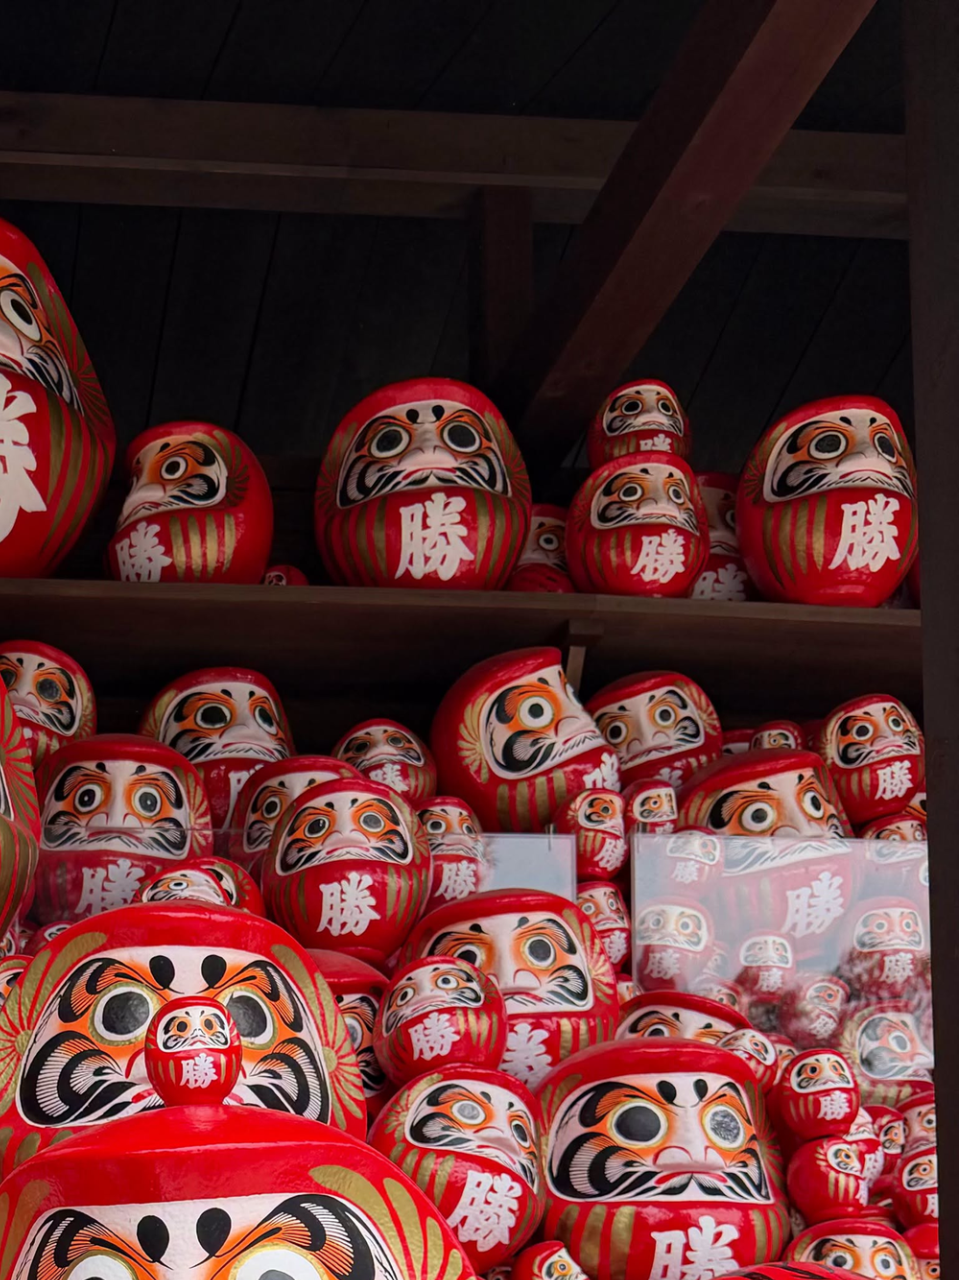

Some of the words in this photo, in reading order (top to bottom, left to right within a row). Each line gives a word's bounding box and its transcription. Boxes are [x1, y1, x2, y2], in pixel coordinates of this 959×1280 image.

[115, 521, 172, 582] 勝
[395, 492, 474, 581] 勝
[631, 528, 685, 583] 勝
[828, 493, 901, 573] 勝
[874, 759, 913, 800] 勝
[434, 860, 478, 900] 勝
[593, 837, 627, 872] 勝
[74, 858, 145, 915] 勝
[316, 871, 381, 937] 勝
[781, 871, 844, 938] 勝
[644, 949, 681, 980] 勝
[880, 952, 914, 984] 勝
[408, 1012, 461, 1061] 勝
[180, 1052, 218, 1089] 勝
[817, 1090, 851, 1121] 勝
[446, 1170, 523, 1252] 勝
